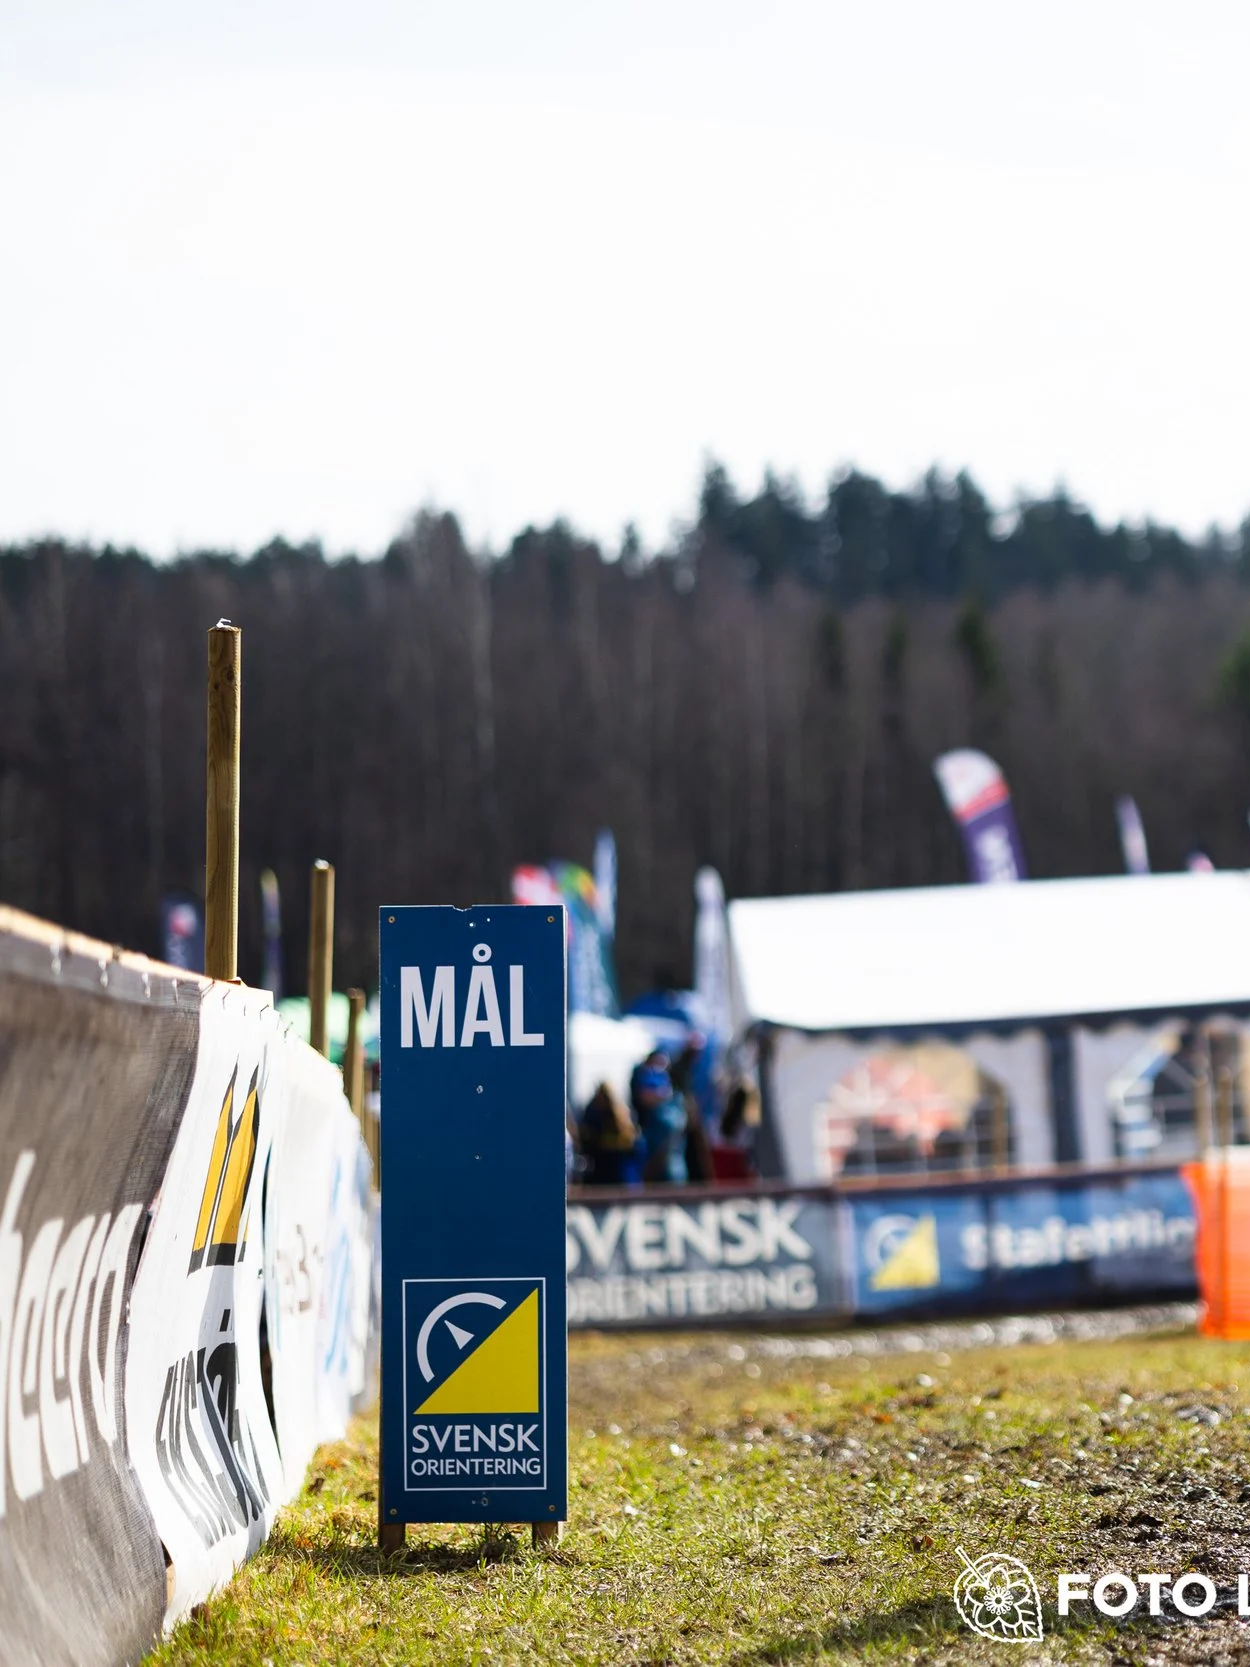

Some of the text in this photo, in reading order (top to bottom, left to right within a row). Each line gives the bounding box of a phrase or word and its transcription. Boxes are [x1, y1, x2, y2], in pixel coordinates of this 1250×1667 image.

[400, 943, 545, 1048] MÅL
[412, 1423, 540, 1453] SVENSK
[411, 1457, 541, 1476] ORIENTERING
